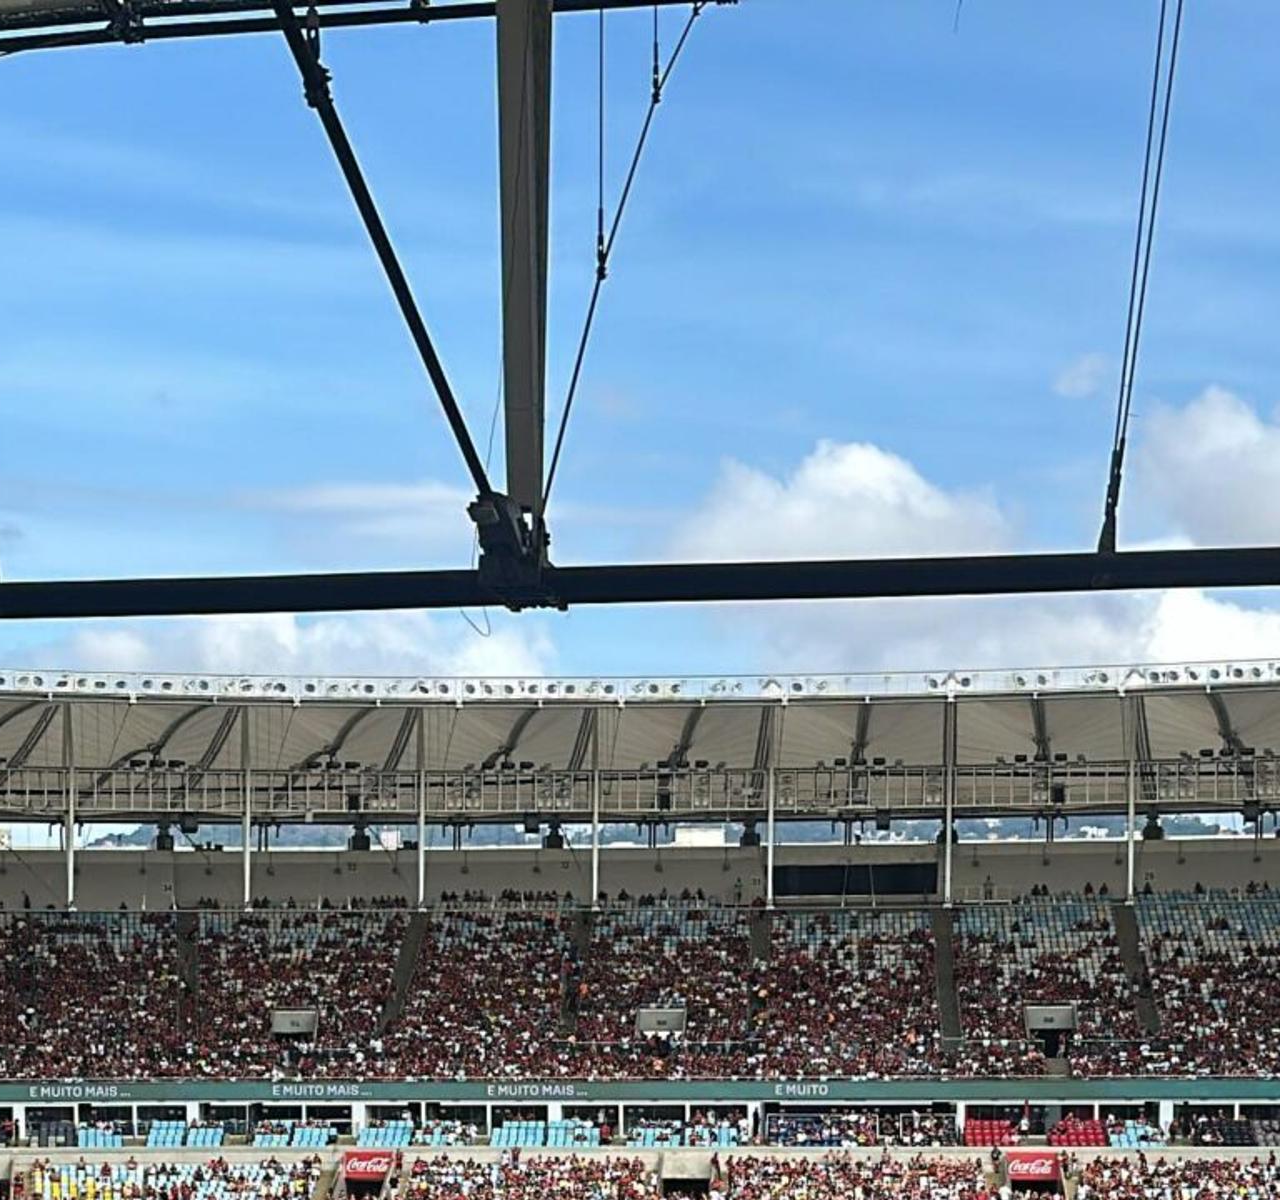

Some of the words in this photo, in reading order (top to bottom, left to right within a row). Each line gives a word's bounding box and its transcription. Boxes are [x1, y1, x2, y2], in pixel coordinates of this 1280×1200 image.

[30, 1086, 38, 1098] E
[40, 1086, 82, 1098] MUITO
[83, 1086, 117, 1098] MAIS
[272, 1085, 280, 1096] E
[283, 1085, 324, 1096] MUITO
[326, 1085, 359, 1096] MAIS
[487, 1085, 495, 1096] E
[498, 1085, 539, 1096] MUITO
[542, 1085, 574, 1096] MAIS
[775, 1085, 783, 1095] E
[787, 1085, 828, 1095] MUITO
